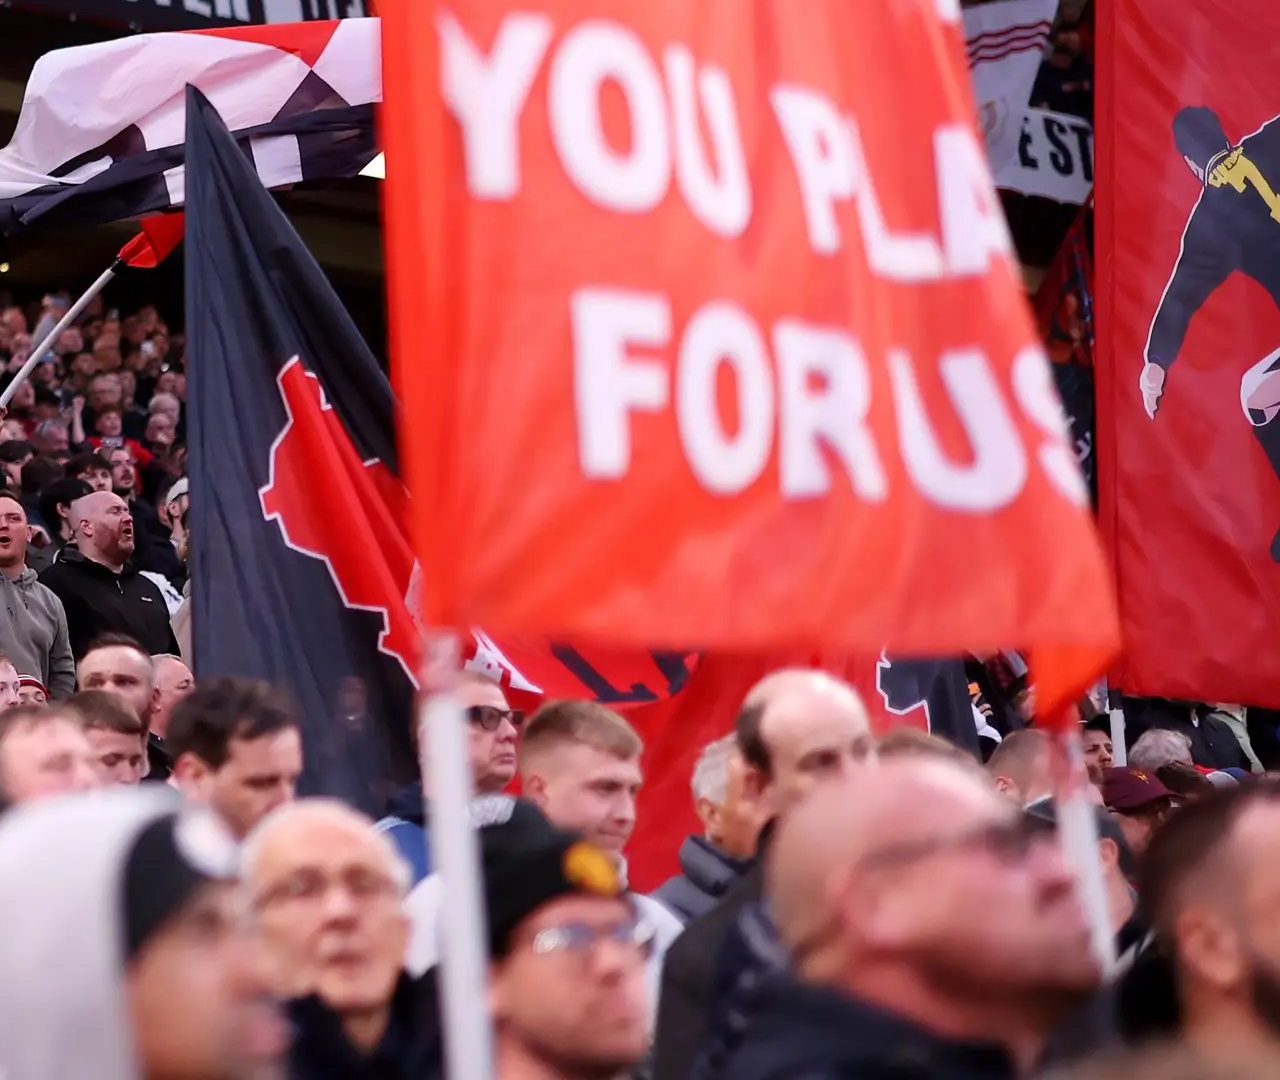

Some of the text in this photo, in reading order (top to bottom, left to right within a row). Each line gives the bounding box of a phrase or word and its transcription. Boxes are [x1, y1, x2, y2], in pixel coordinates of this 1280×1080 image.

[439, 10, 1008, 283] YOU PLA
[1043, 117, 1093, 184] ST
[570, 283, 888, 503] FOR
